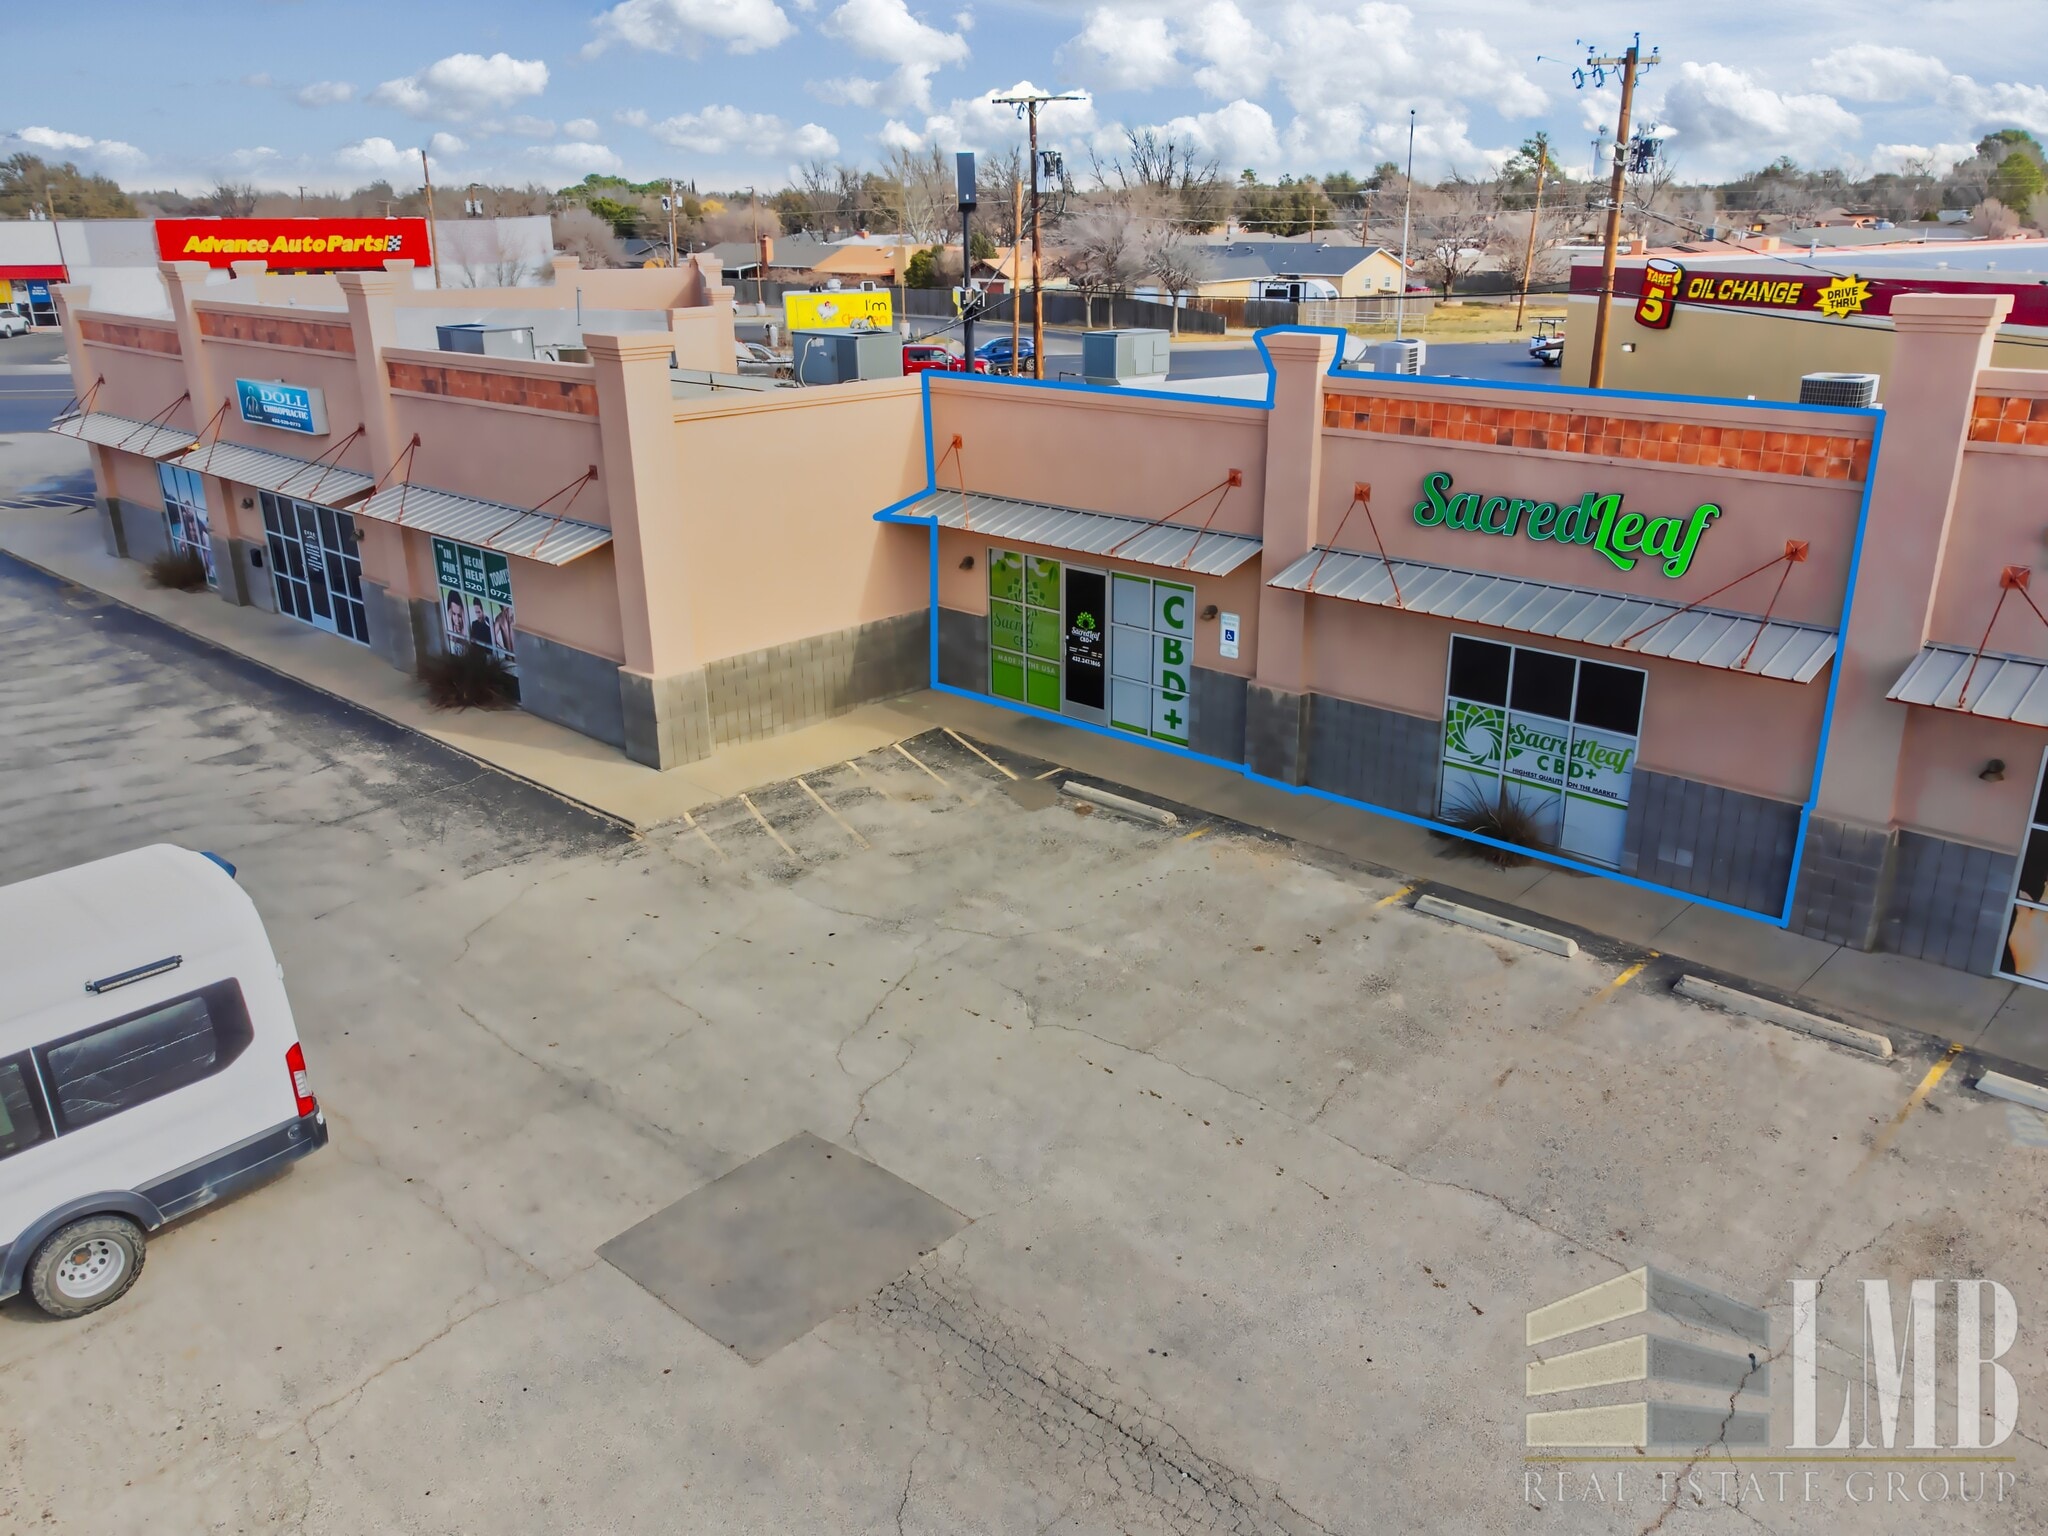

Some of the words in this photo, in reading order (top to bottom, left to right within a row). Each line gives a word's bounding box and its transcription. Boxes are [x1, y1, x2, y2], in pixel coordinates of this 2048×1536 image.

[183, 235, 269, 253] Advance
[270, 235, 326, 253] Auto
[326, 235, 384, 253] Parts
[1646, 268, 1673, 287] TAKE
[1687, 277, 1716, 300] OIL
[1717, 279, 1804, 305] CHANGE
[1827, 286, 1859, 300] DRIVE
[865, 299, 887, 311] I'm
[1640, 287, 1665, 322] 5
[1829, 297, 1857, 309] THRU
[260, 389, 307, 407] DOLL
[263, 404, 309, 420] CHIROPRACTIC
[465, 568, 484, 582] HELP
[998, 654, 1017, 663] MADE
[1041, 665, 1056, 675] USA
[1536, 755, 1597, 779] CBD+
[1512, 768, 1537, 779] HIGHEST
[1538, 774, 1563, 785] QUALITY
[1567, 781, 1578, 789] ON
[1579, 784, 1591, 792] THE
[1592, 787, 1618, 798] MARKET
